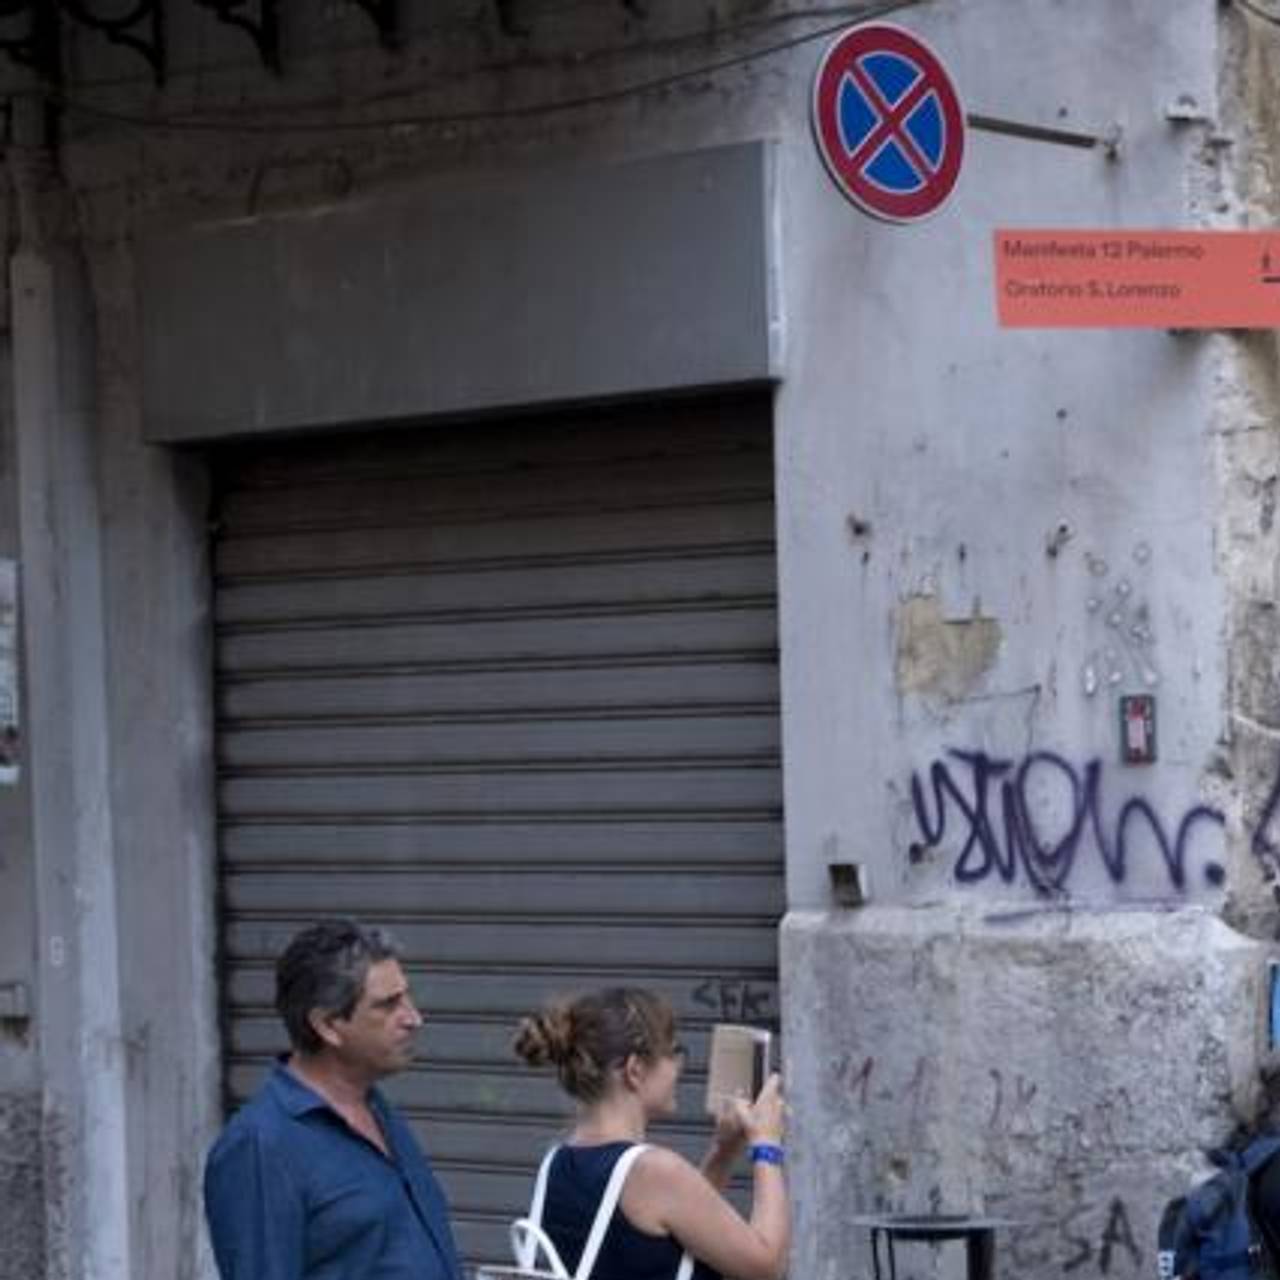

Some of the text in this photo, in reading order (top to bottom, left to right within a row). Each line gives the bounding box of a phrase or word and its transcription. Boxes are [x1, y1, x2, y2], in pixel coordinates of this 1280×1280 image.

[1003, 240, 1204, 259] Manifesta 12 Palermo
[1005, 279, 1182, 299] Oratorio S. Lorenzo
